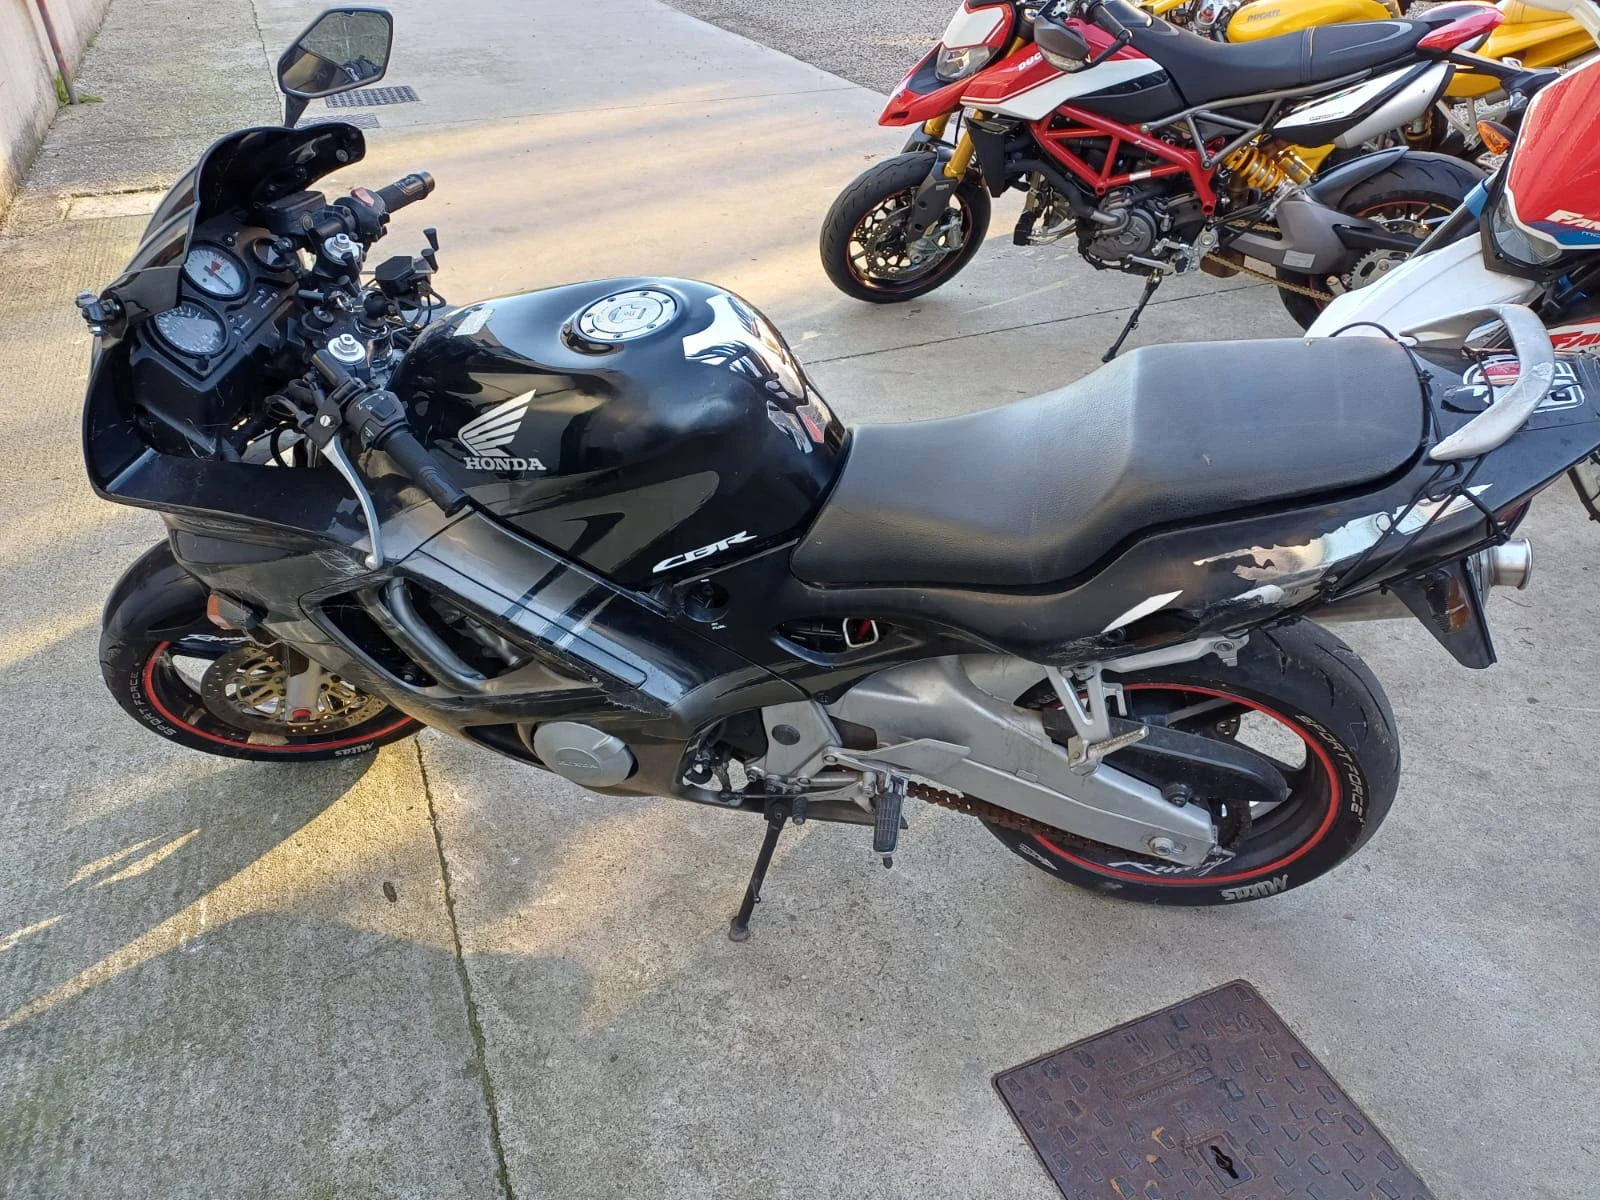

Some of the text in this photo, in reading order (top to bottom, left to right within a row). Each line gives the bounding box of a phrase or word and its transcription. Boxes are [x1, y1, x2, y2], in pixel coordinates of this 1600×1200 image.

[463, 457, 547, 471] HONDA
[652, 530, 758, 573] CBR
[138, 707, 177, 736] SPORT
[1295, 714, 1353, 763] SPORT
